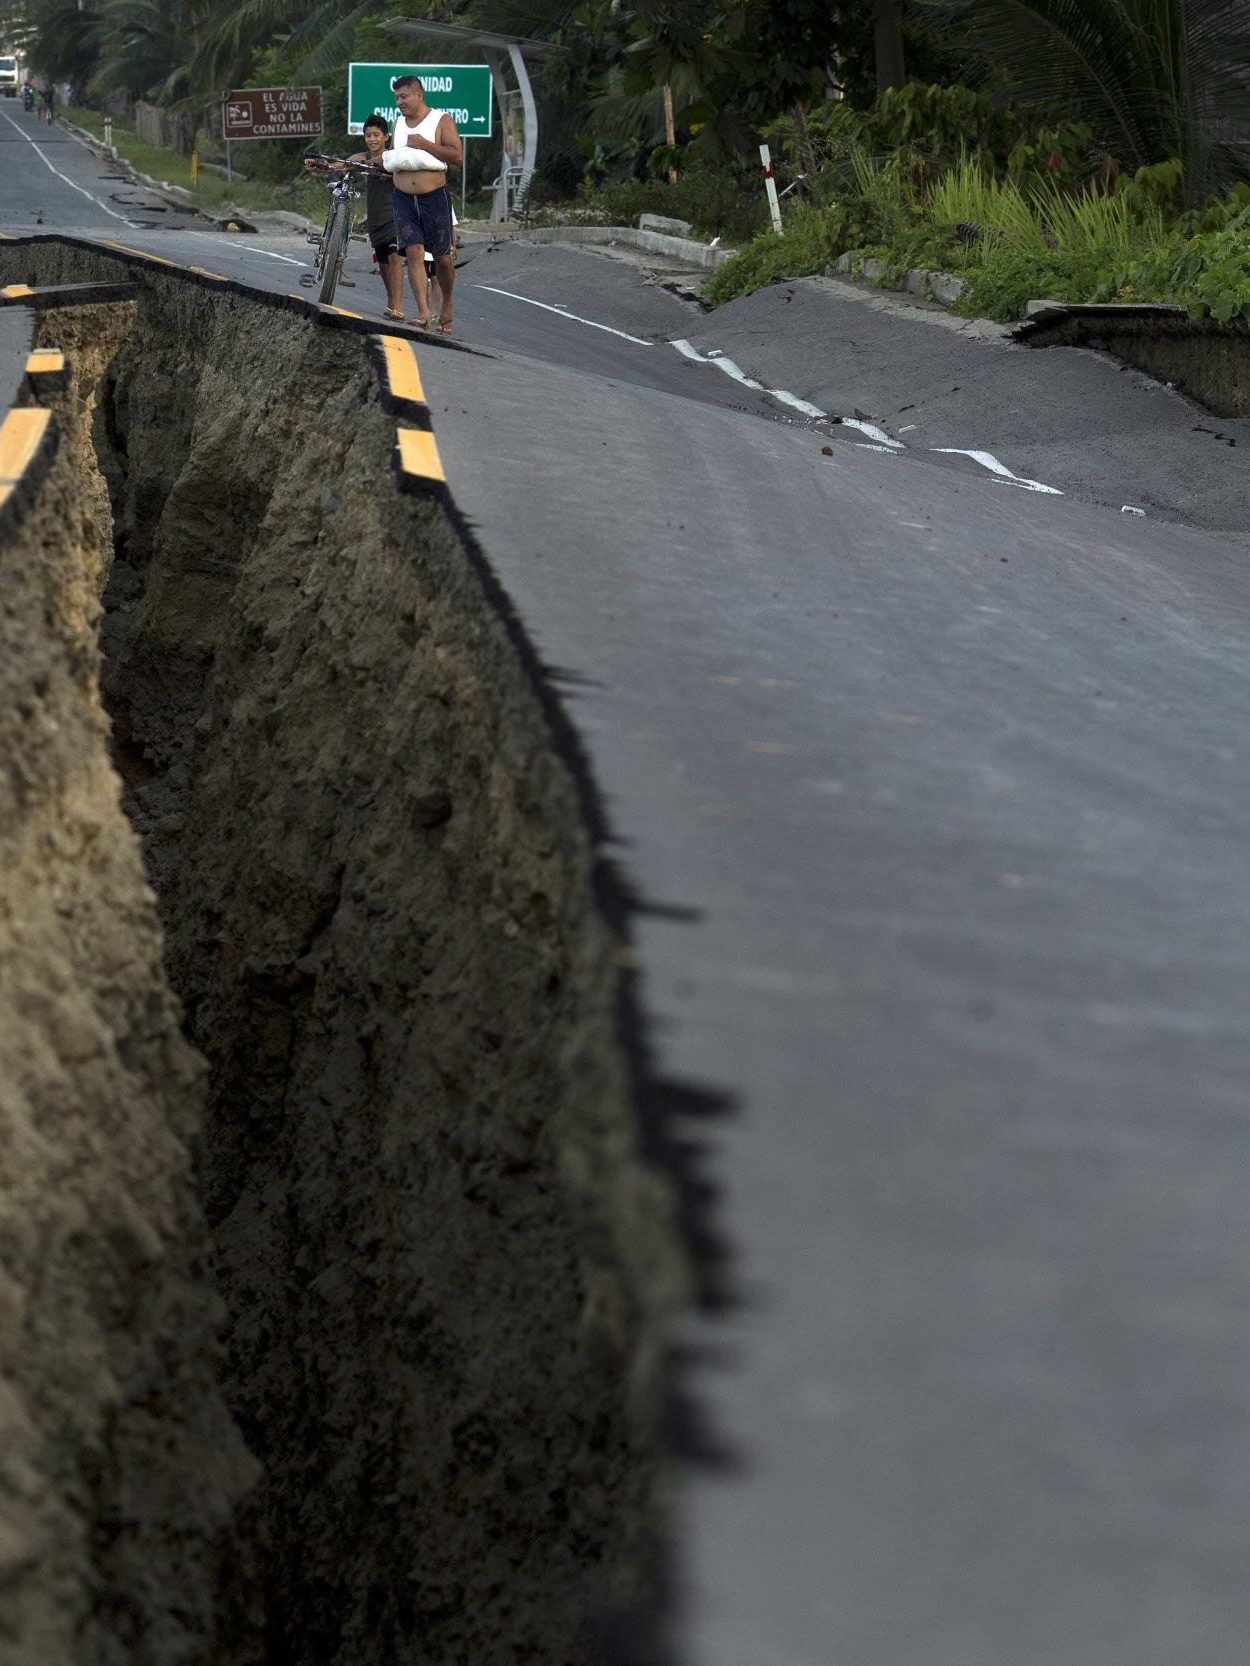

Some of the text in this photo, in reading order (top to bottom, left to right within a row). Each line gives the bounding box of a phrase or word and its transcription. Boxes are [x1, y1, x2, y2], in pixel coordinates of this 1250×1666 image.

[390, 76, 452, 92] CNIDAD
[263, 93, 274, 102] EL
[265, 102, 307, 113] ES VIDA
[269, 112, 303, 123] NO LA
[253, 122, 321, 134] CONTAMINES
